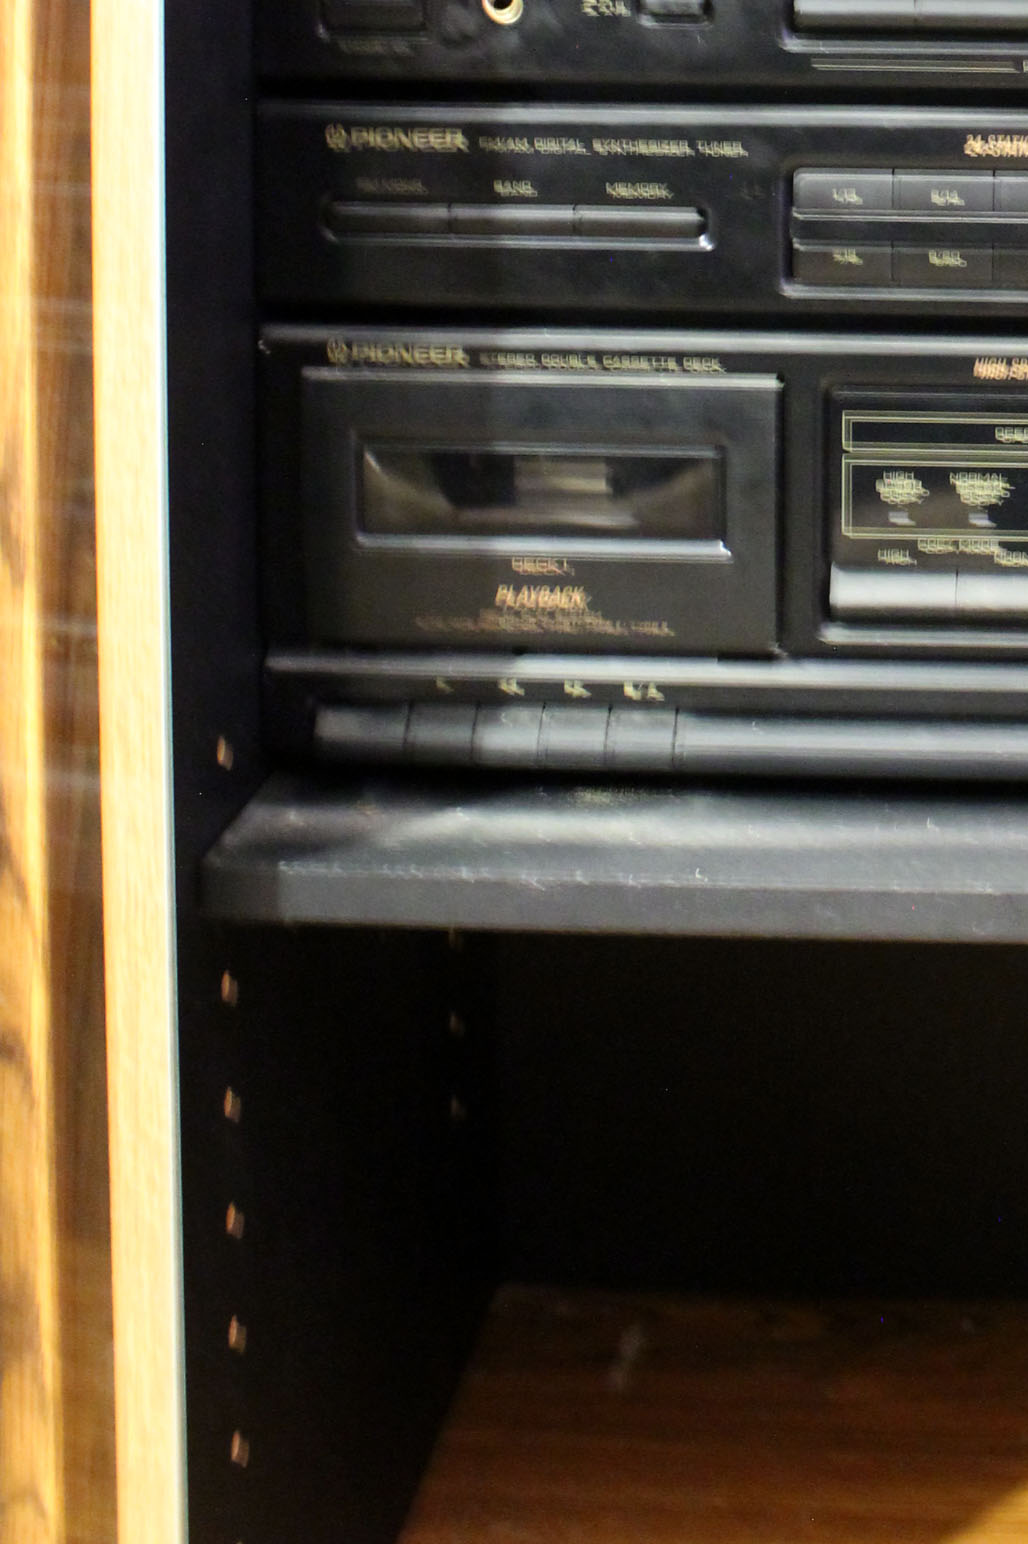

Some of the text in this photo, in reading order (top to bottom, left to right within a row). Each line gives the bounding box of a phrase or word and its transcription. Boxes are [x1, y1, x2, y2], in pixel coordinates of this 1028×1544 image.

[351, 127, 469, 153] PIONEER
[534, 136, 590, 155] DIGITAL
[695, 140, 750, 158] TUNER
[493, 179, 538, 197] BAND
[605, 181, 674, 200] MEMORY
[351, 341, 469, 368] PIONEER
[681, 357, 726, 373] DECK
[973, 358, 1011, 380] HIGH
[950, 472, 1015, 489] NORMAL
[878, 549, 917, 566] HIGH
[495, 584, 591, 610] PLAYBACK
